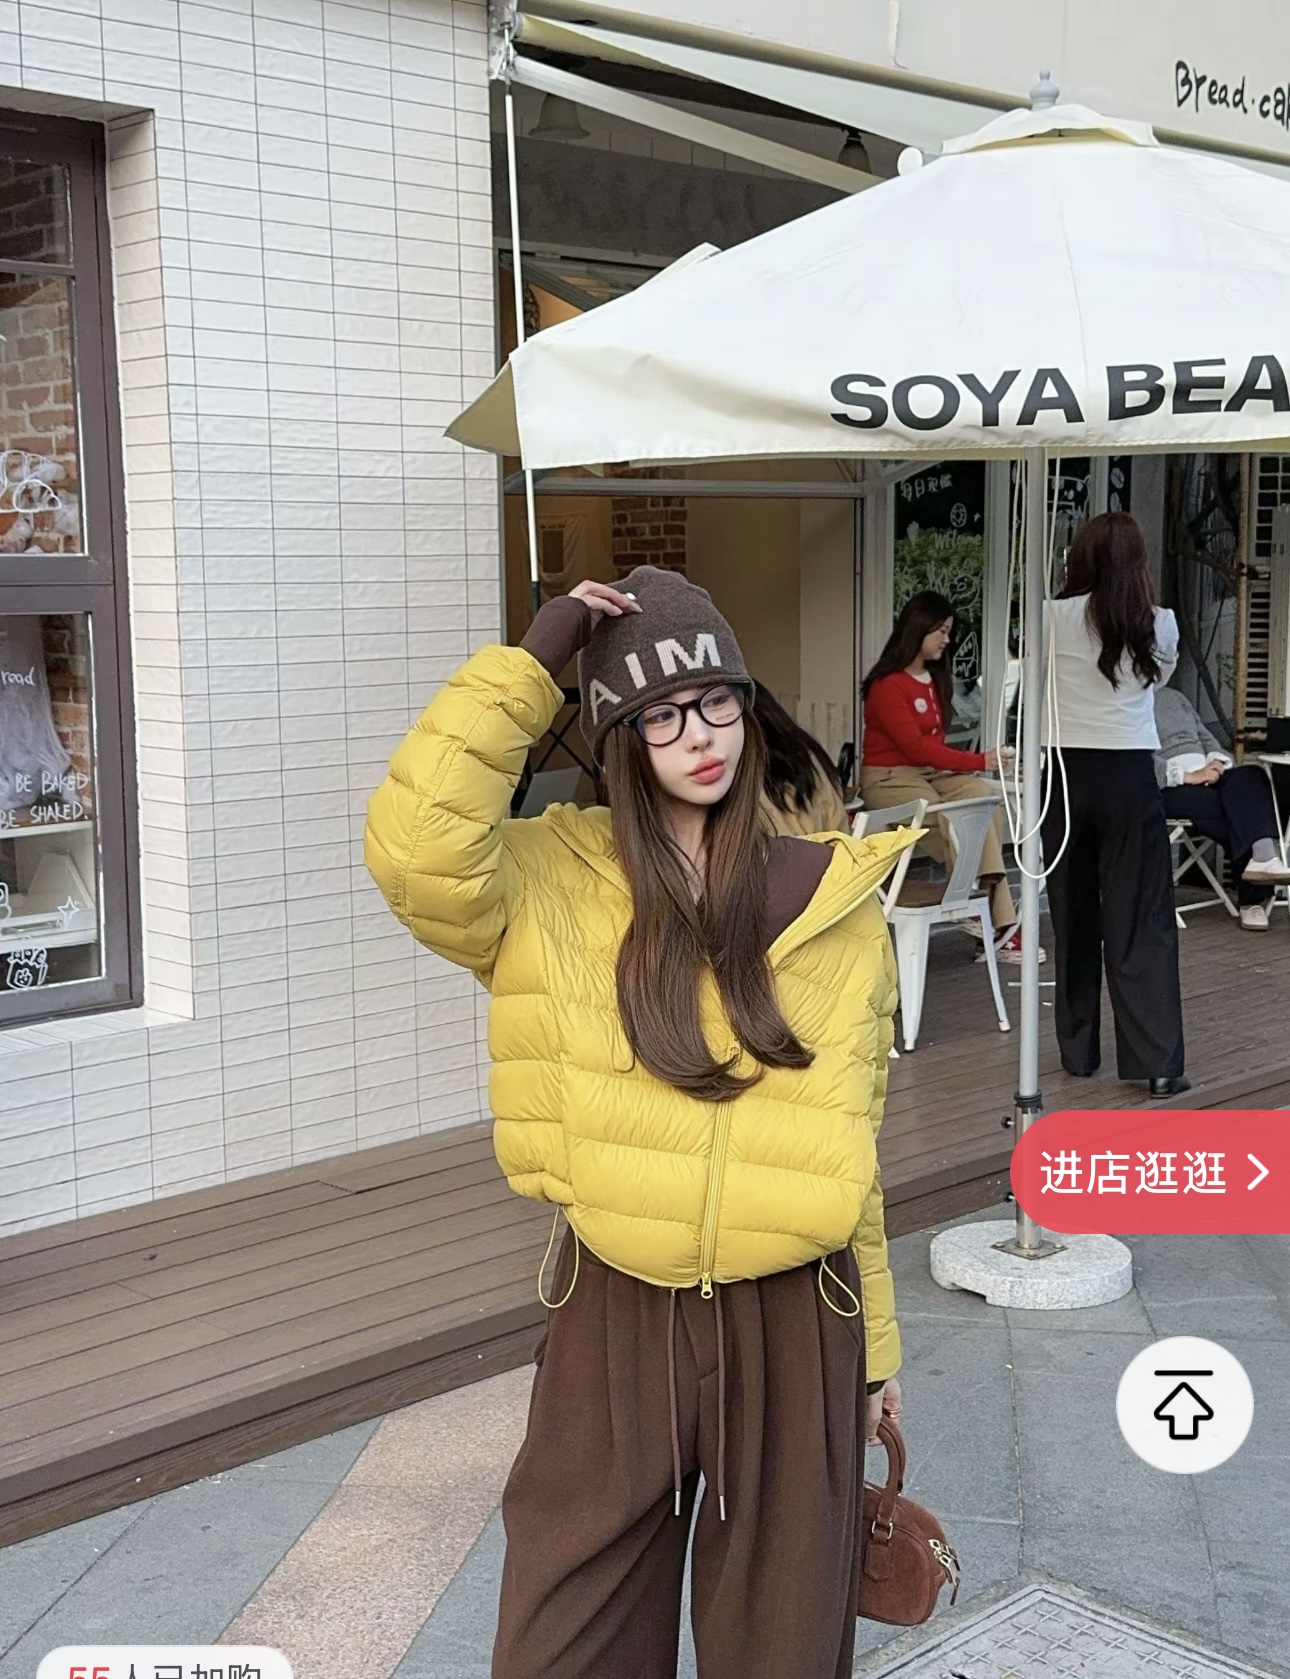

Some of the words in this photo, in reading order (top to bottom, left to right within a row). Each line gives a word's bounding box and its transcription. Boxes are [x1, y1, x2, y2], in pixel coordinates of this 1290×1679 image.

[830, 367, 1085, 431] SOYA
[1106, 355, 1290, 421] BEA
[589, 633, 722, 726] AIM
[15, 772, 33, 793] BE
[41, 770, 90, 796] BAKED
